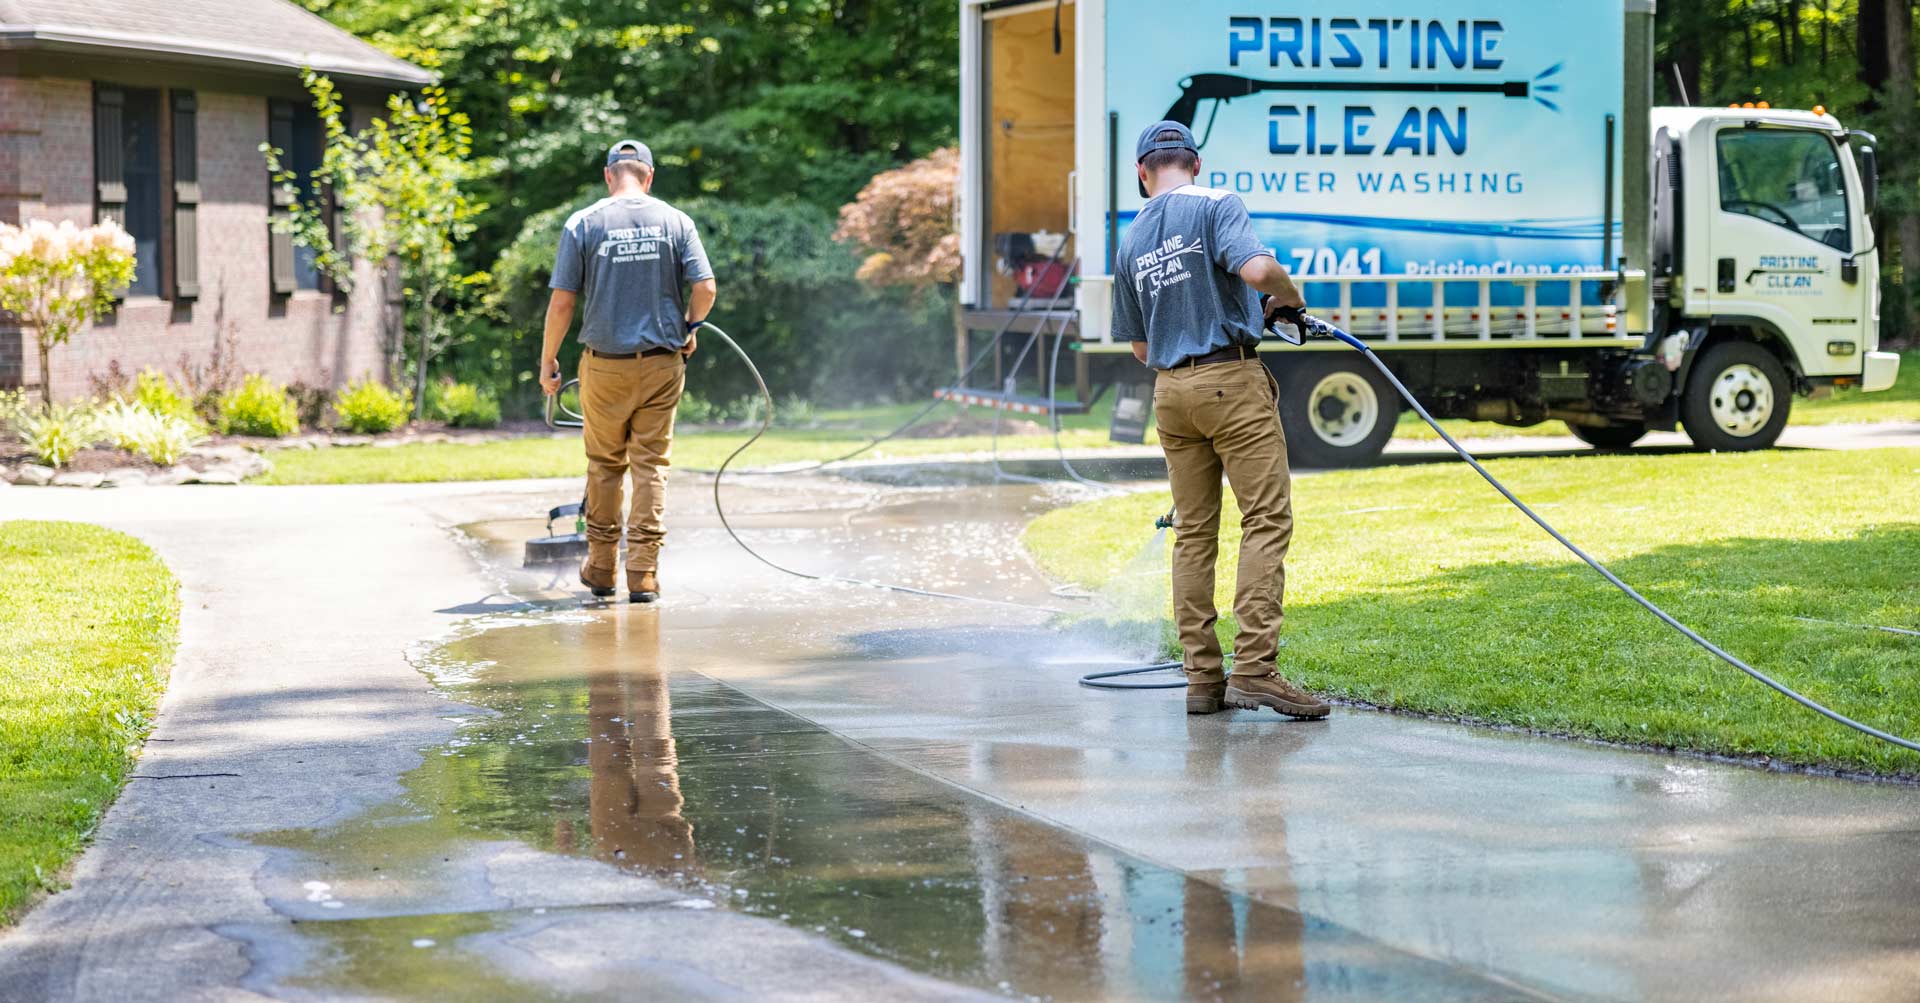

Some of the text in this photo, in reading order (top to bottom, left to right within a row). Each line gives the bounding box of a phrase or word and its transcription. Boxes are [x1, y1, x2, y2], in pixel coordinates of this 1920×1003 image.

[1229, 16, 1504, 69] PRISTINE
[1268, 105, 1467, 156] CLEAN
[1210, 171, 1524, 194] POWER WASHING
[607, 226, 661, 240] PRISTINE
[617, 241, 656, 255] CLEAN
[1136, 235, 1184, 271] PRIINE
[1150, 256, 1183, 286] CAN
[1268, 247, 1604, 275] -7041 PristineCleancom
[1759, 256, 1819, 268] PRISTINE
[1768, 276, 1811, 287] CLEAN
